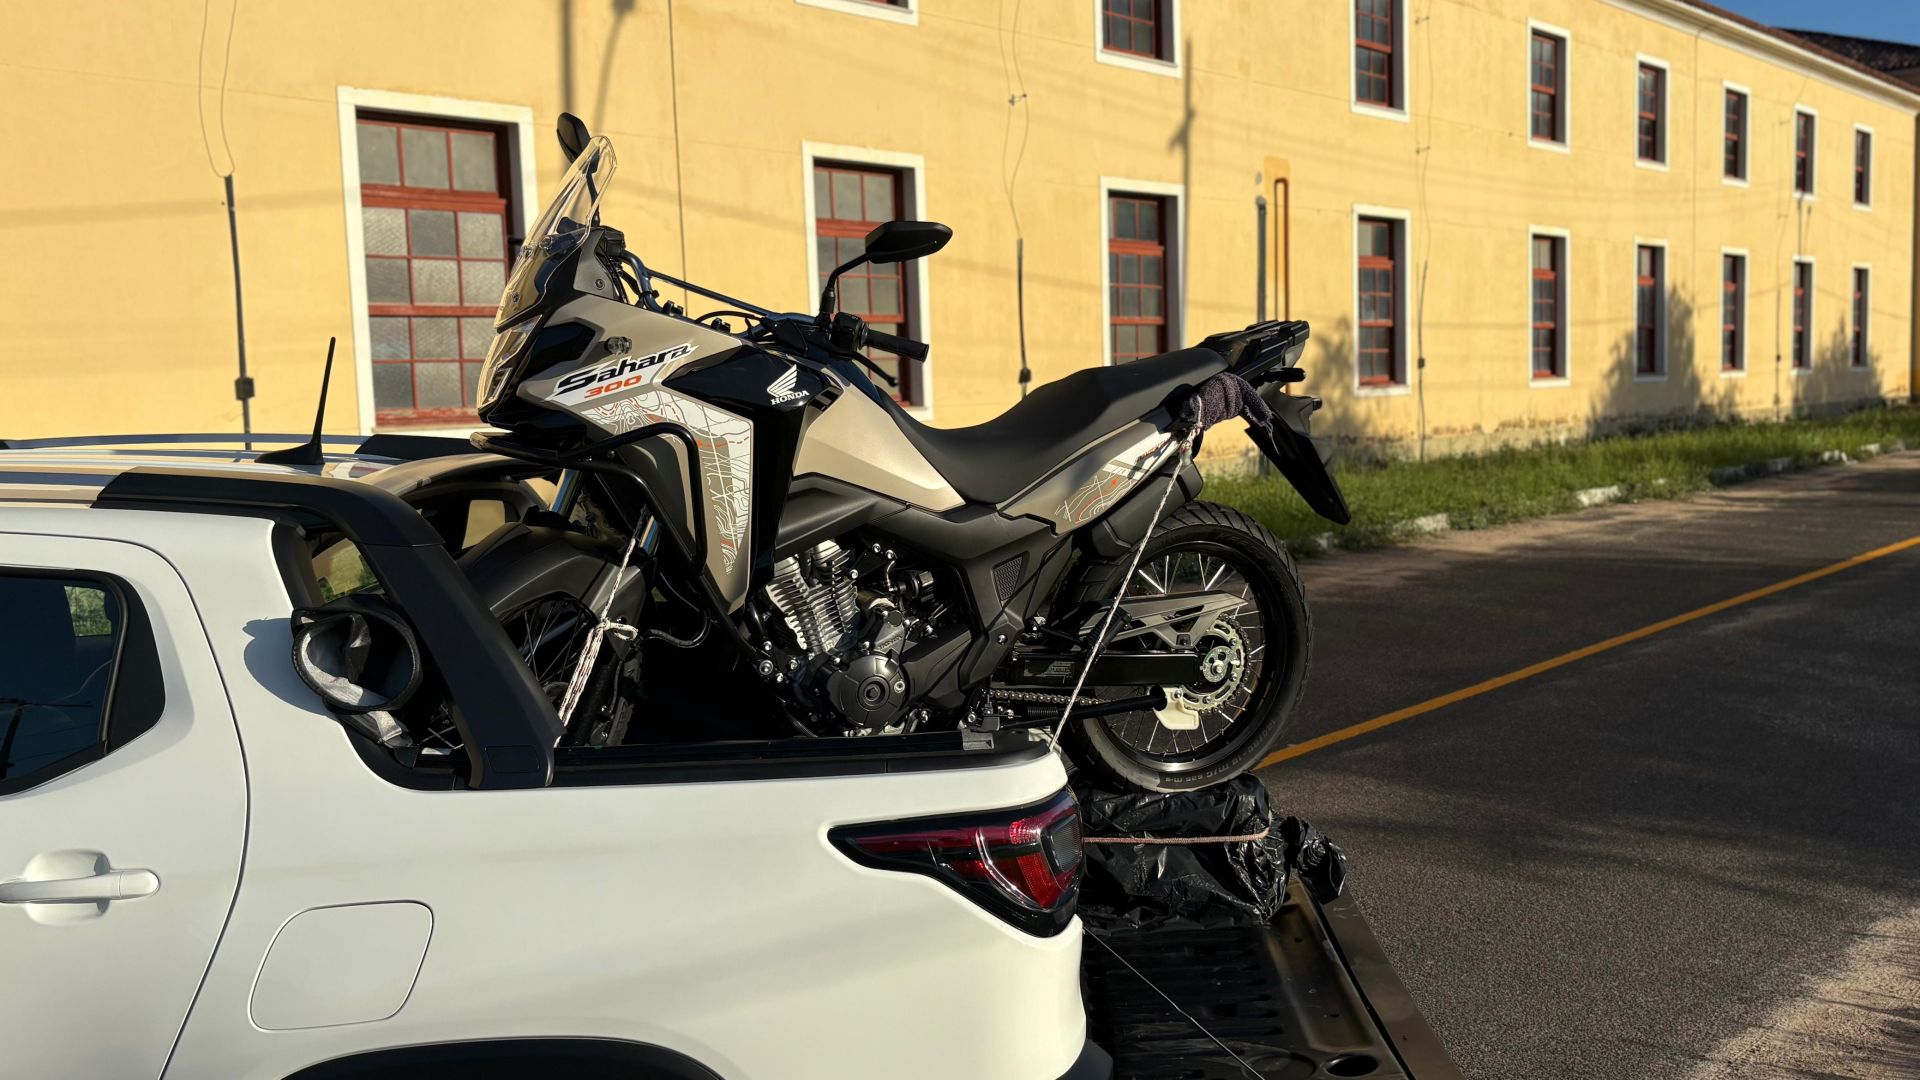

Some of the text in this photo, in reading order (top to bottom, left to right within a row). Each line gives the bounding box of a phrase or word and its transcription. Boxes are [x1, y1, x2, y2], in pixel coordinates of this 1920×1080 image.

[553, 345, 689, 397] Sahara
[584, 374, 643, 399] 300
[771, 390, 810, 405] HONDA
